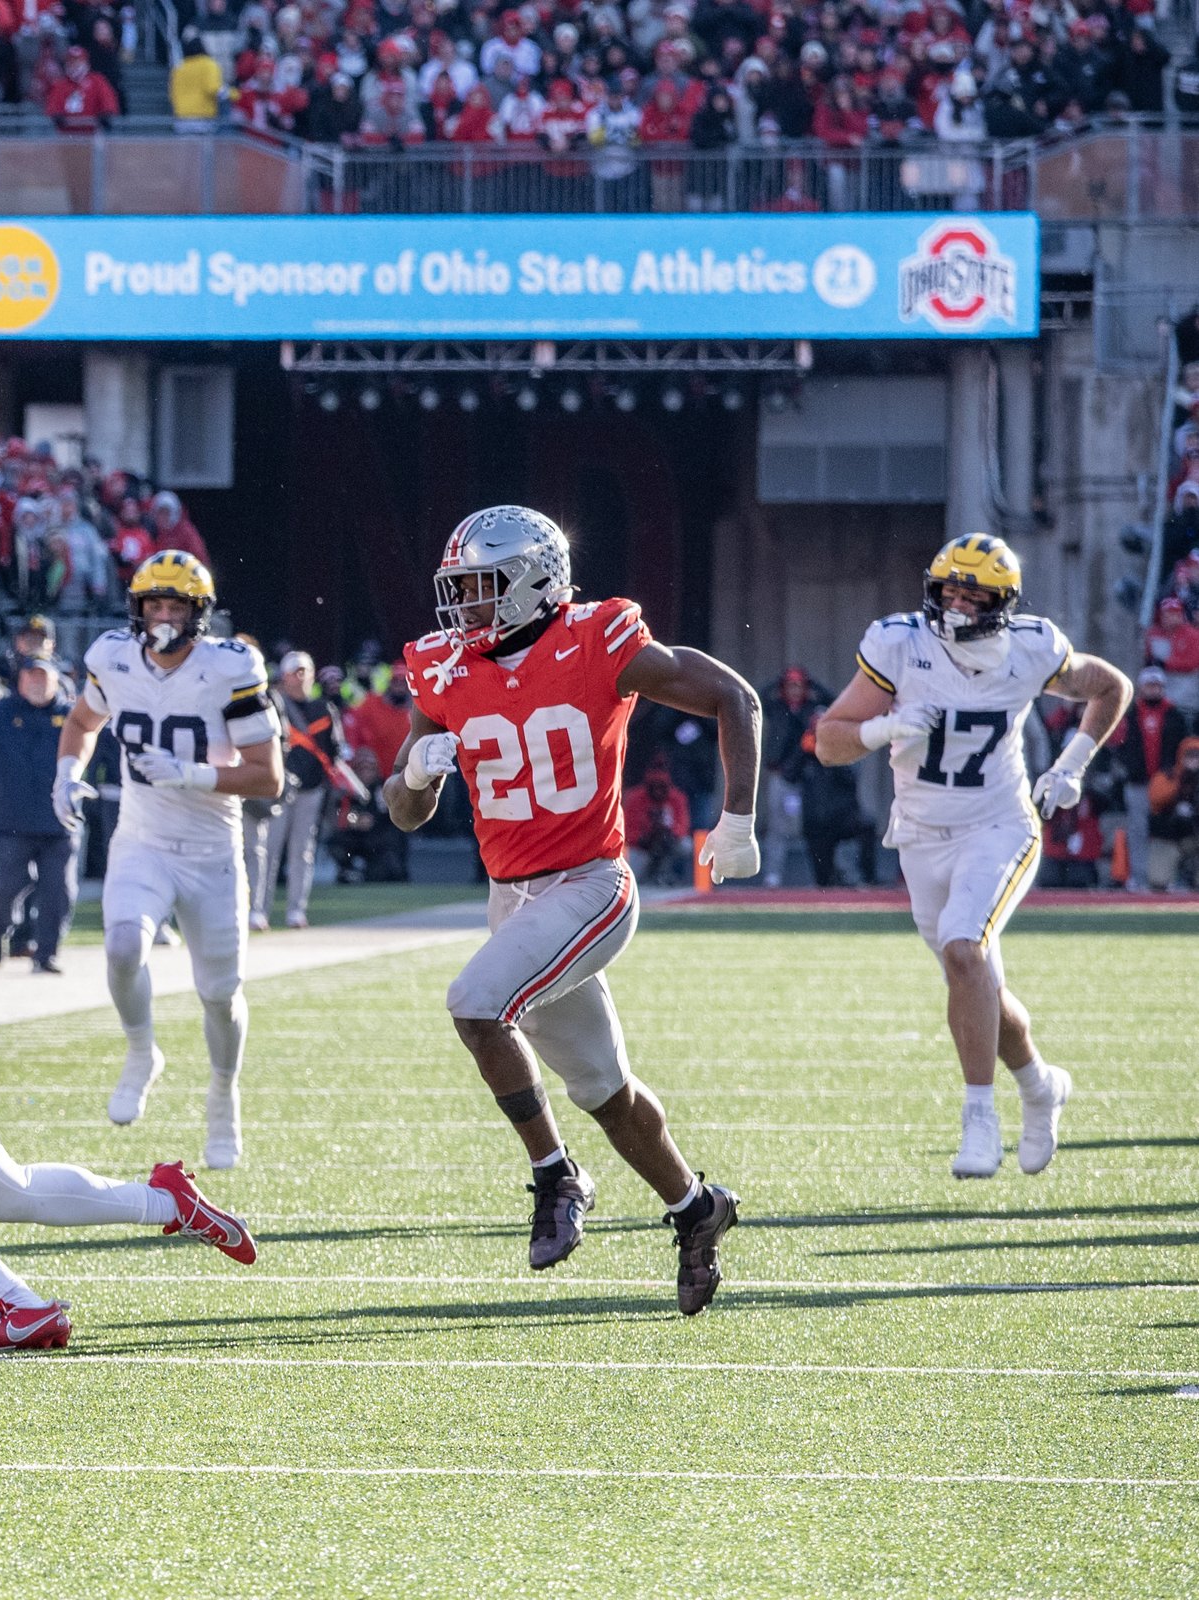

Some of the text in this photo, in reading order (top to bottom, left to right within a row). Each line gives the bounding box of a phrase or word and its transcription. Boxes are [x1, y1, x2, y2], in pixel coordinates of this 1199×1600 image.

[85, 249, 806, 305] Proud Sponsor of Ohio State Athletics
[116, 710, 209, 785] 80
[459, 702, 599, 821] 20
[917, 709, 1008, 788] 17
